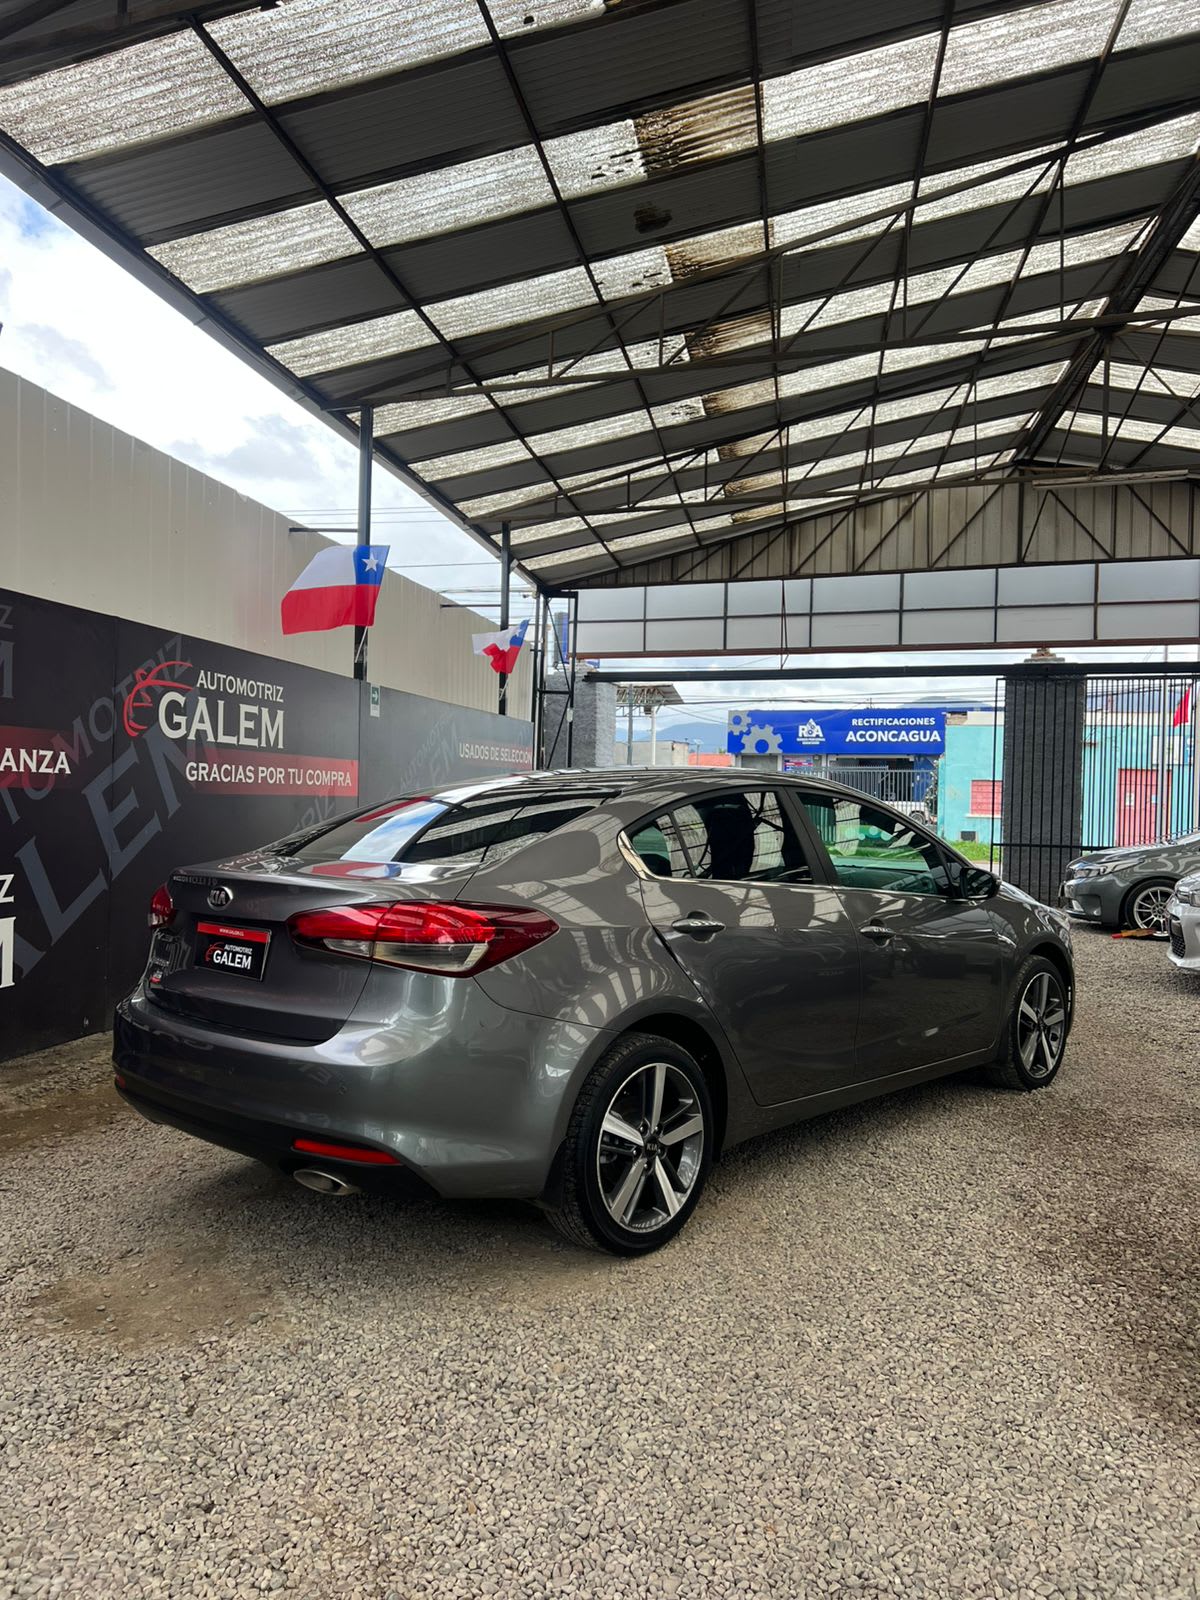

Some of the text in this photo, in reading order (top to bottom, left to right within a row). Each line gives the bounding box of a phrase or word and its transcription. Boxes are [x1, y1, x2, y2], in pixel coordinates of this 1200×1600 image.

[196, 670, 284, 703] AUTOMOTRIZ
[158, 691, 285, 749] GALEM
[851, 717, 936, 726] RECTIFICACIONES
[845, 730, 942, 743] ACONCAGUA
[459, 743, 490, 760] USADOS
[490, 746, 499, 761] DE
[185, 761, 352, 787] GRACIAS POR TU COMPRA
[210, 890, 226, 905] KIA
[224, 943, 253, 955] AUTOMOTRIZ
[213, 949, 252, 970] GALEM
[647, 1143, 658, 1151] KIA
